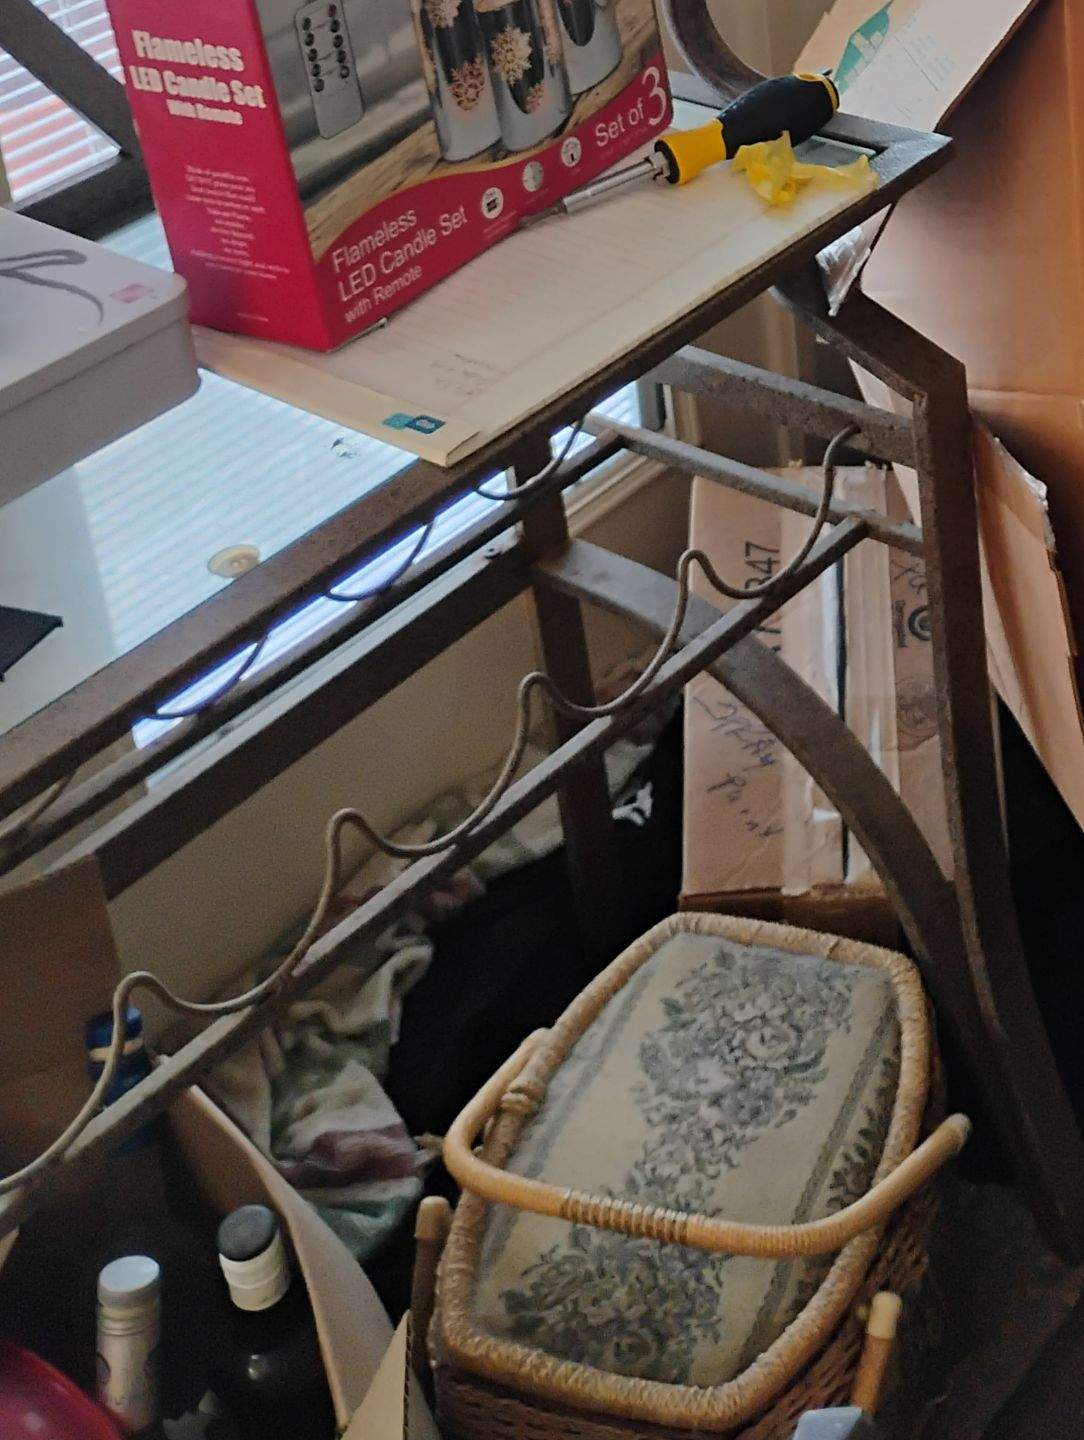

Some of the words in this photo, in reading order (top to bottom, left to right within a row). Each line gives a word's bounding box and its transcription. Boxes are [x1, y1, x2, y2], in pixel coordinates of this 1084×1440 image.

[131, 29, 244, 72] Flameless
[129, 65, 164, 93] LED
[162, 70, 231, 103] Candle
[230, 80, 267, 109] Set
[595, 116, 626, 147] Set
[628, 98, 644, 125] of
[642, 66, 666, 126] 3
[332, 210, 417, 273] Flameless
[338, 263, 376, 302] LED
[380, 229, 437, 274] Candle
[439, 205, 468, 236] Set
[345, 298, 372, 323] with
[373, 265, 423, 305] Remote
